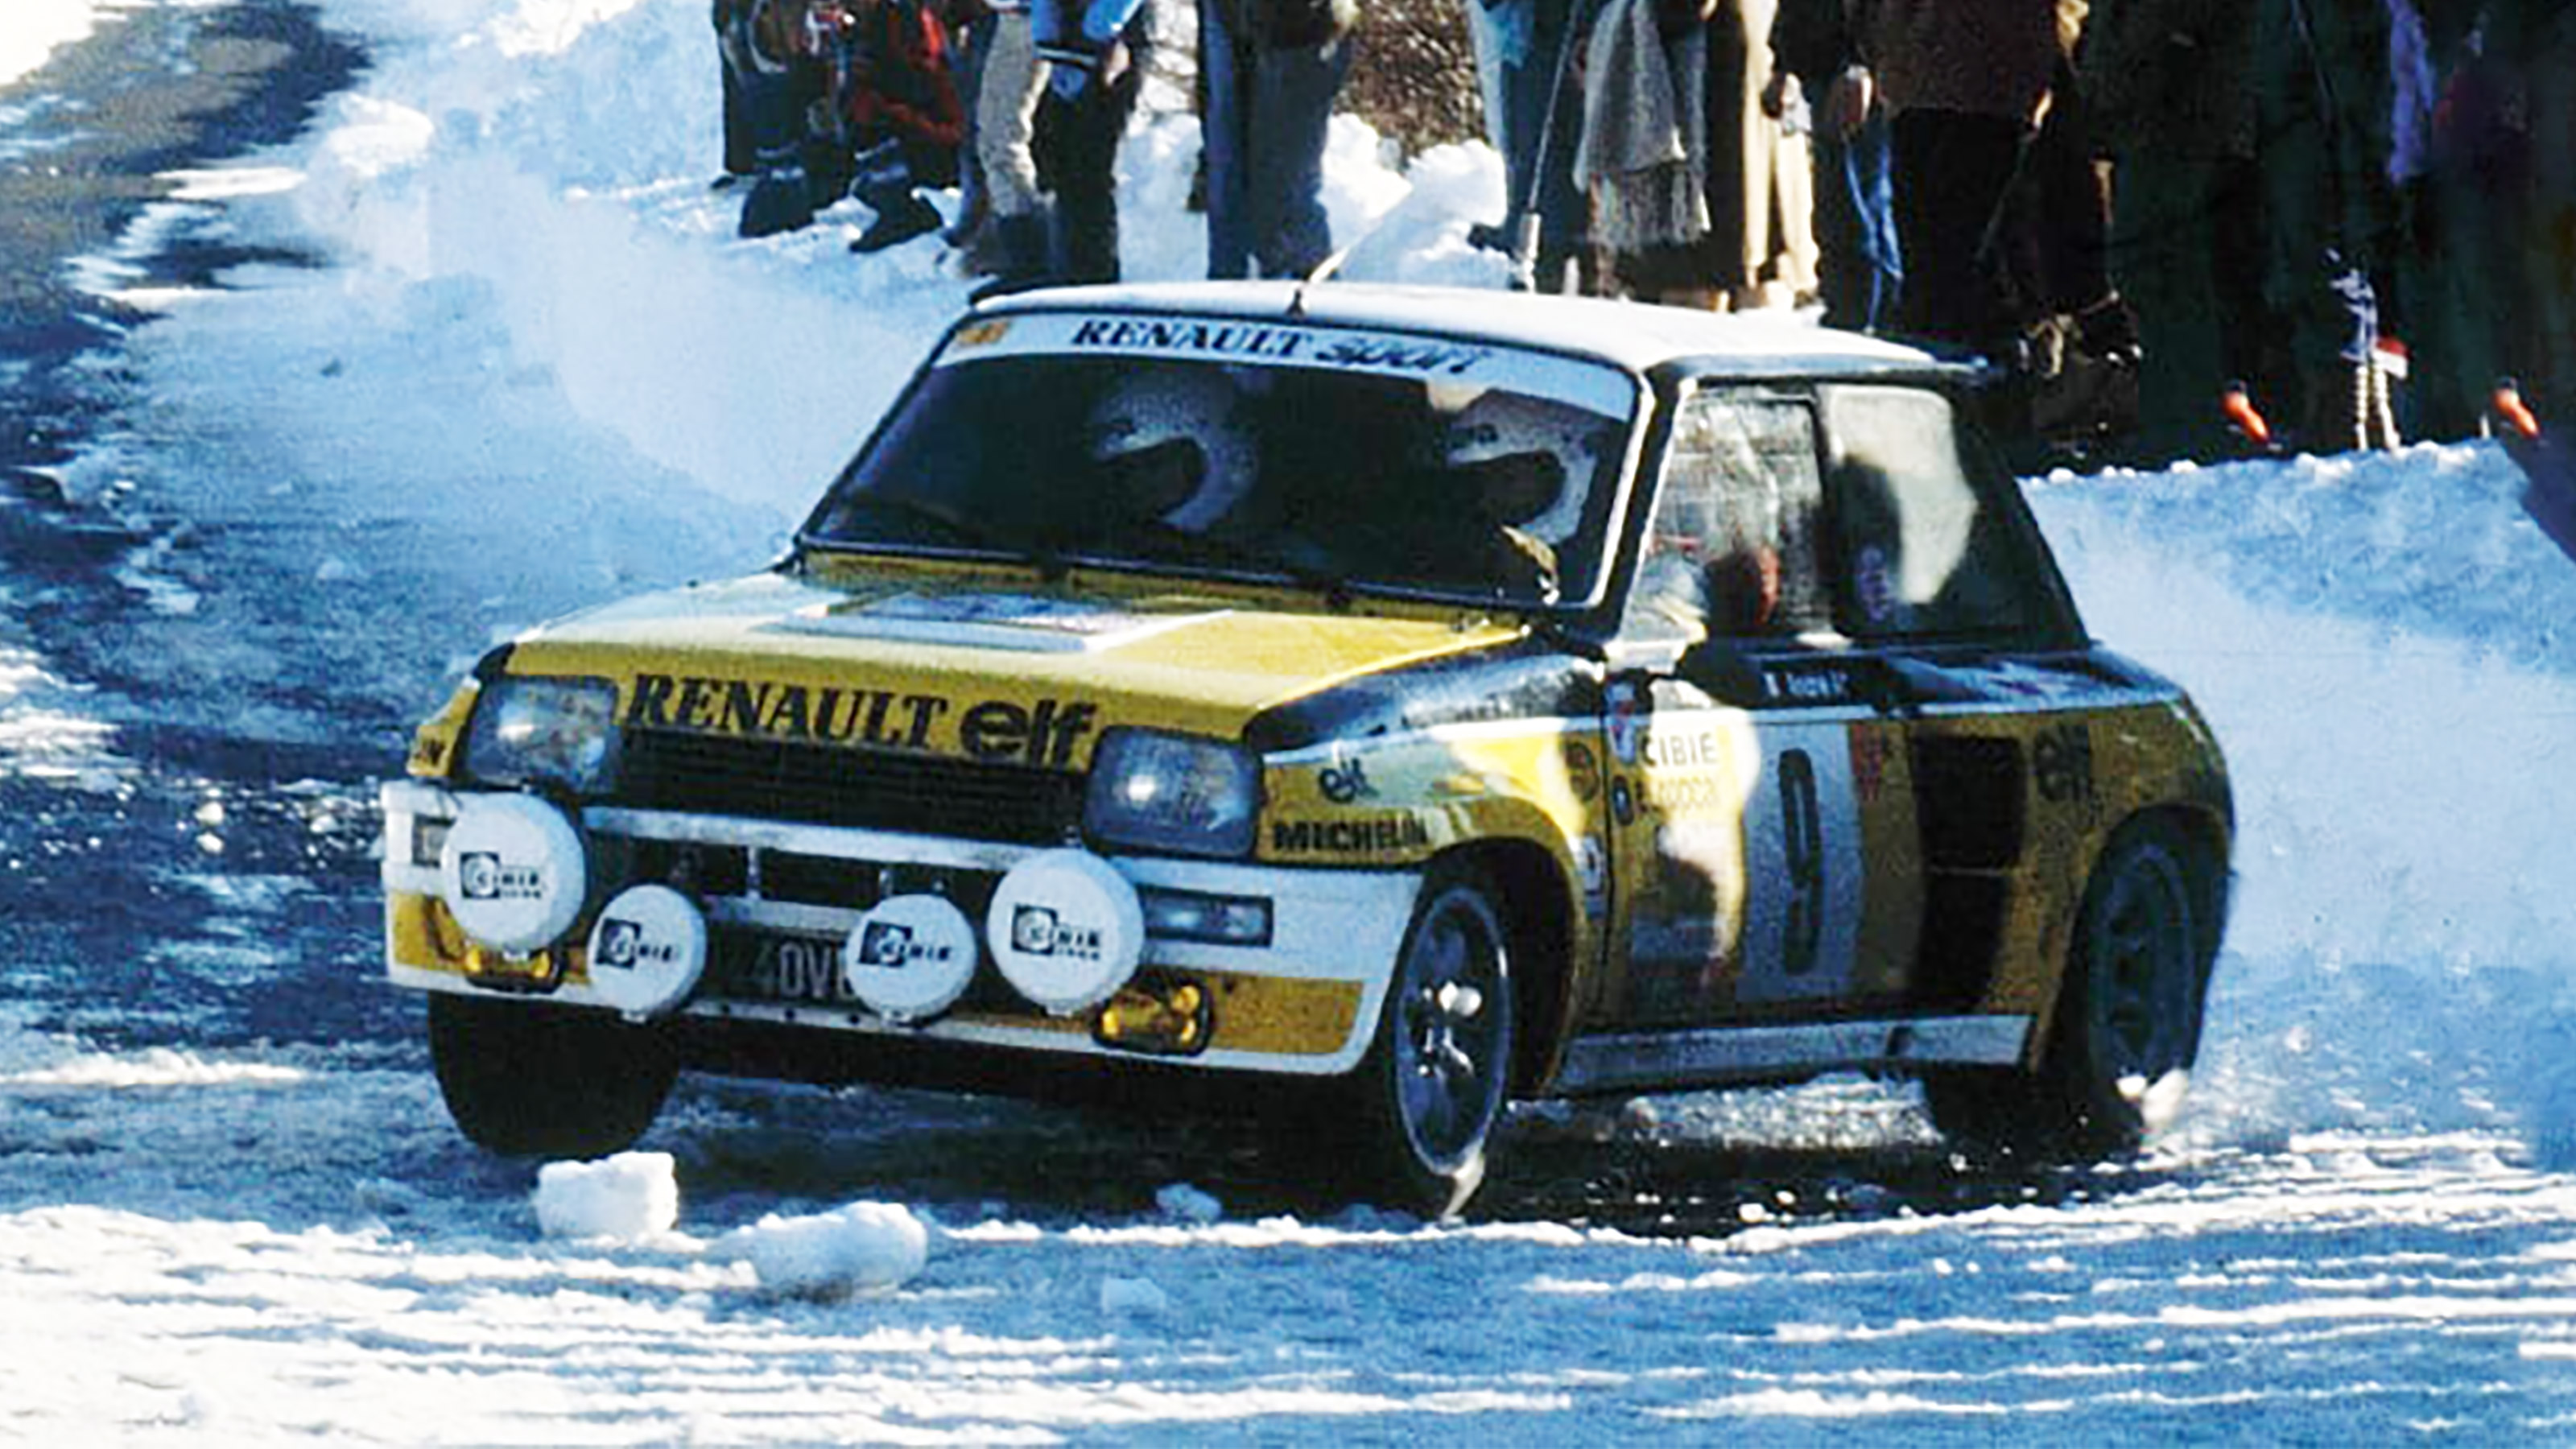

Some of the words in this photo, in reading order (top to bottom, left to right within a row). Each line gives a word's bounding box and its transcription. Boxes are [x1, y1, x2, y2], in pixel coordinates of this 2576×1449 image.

[1071, 320, 1314, 357] RENAULT
[630, 674, 947, 750] RENAULT
[960, 699, 1097, 766] elf
[1641, 731, 1716, 767] CIBIE
[1273, 811, 1428, 852] MICHELIN
[1777, 746, 1823, 976] 9
